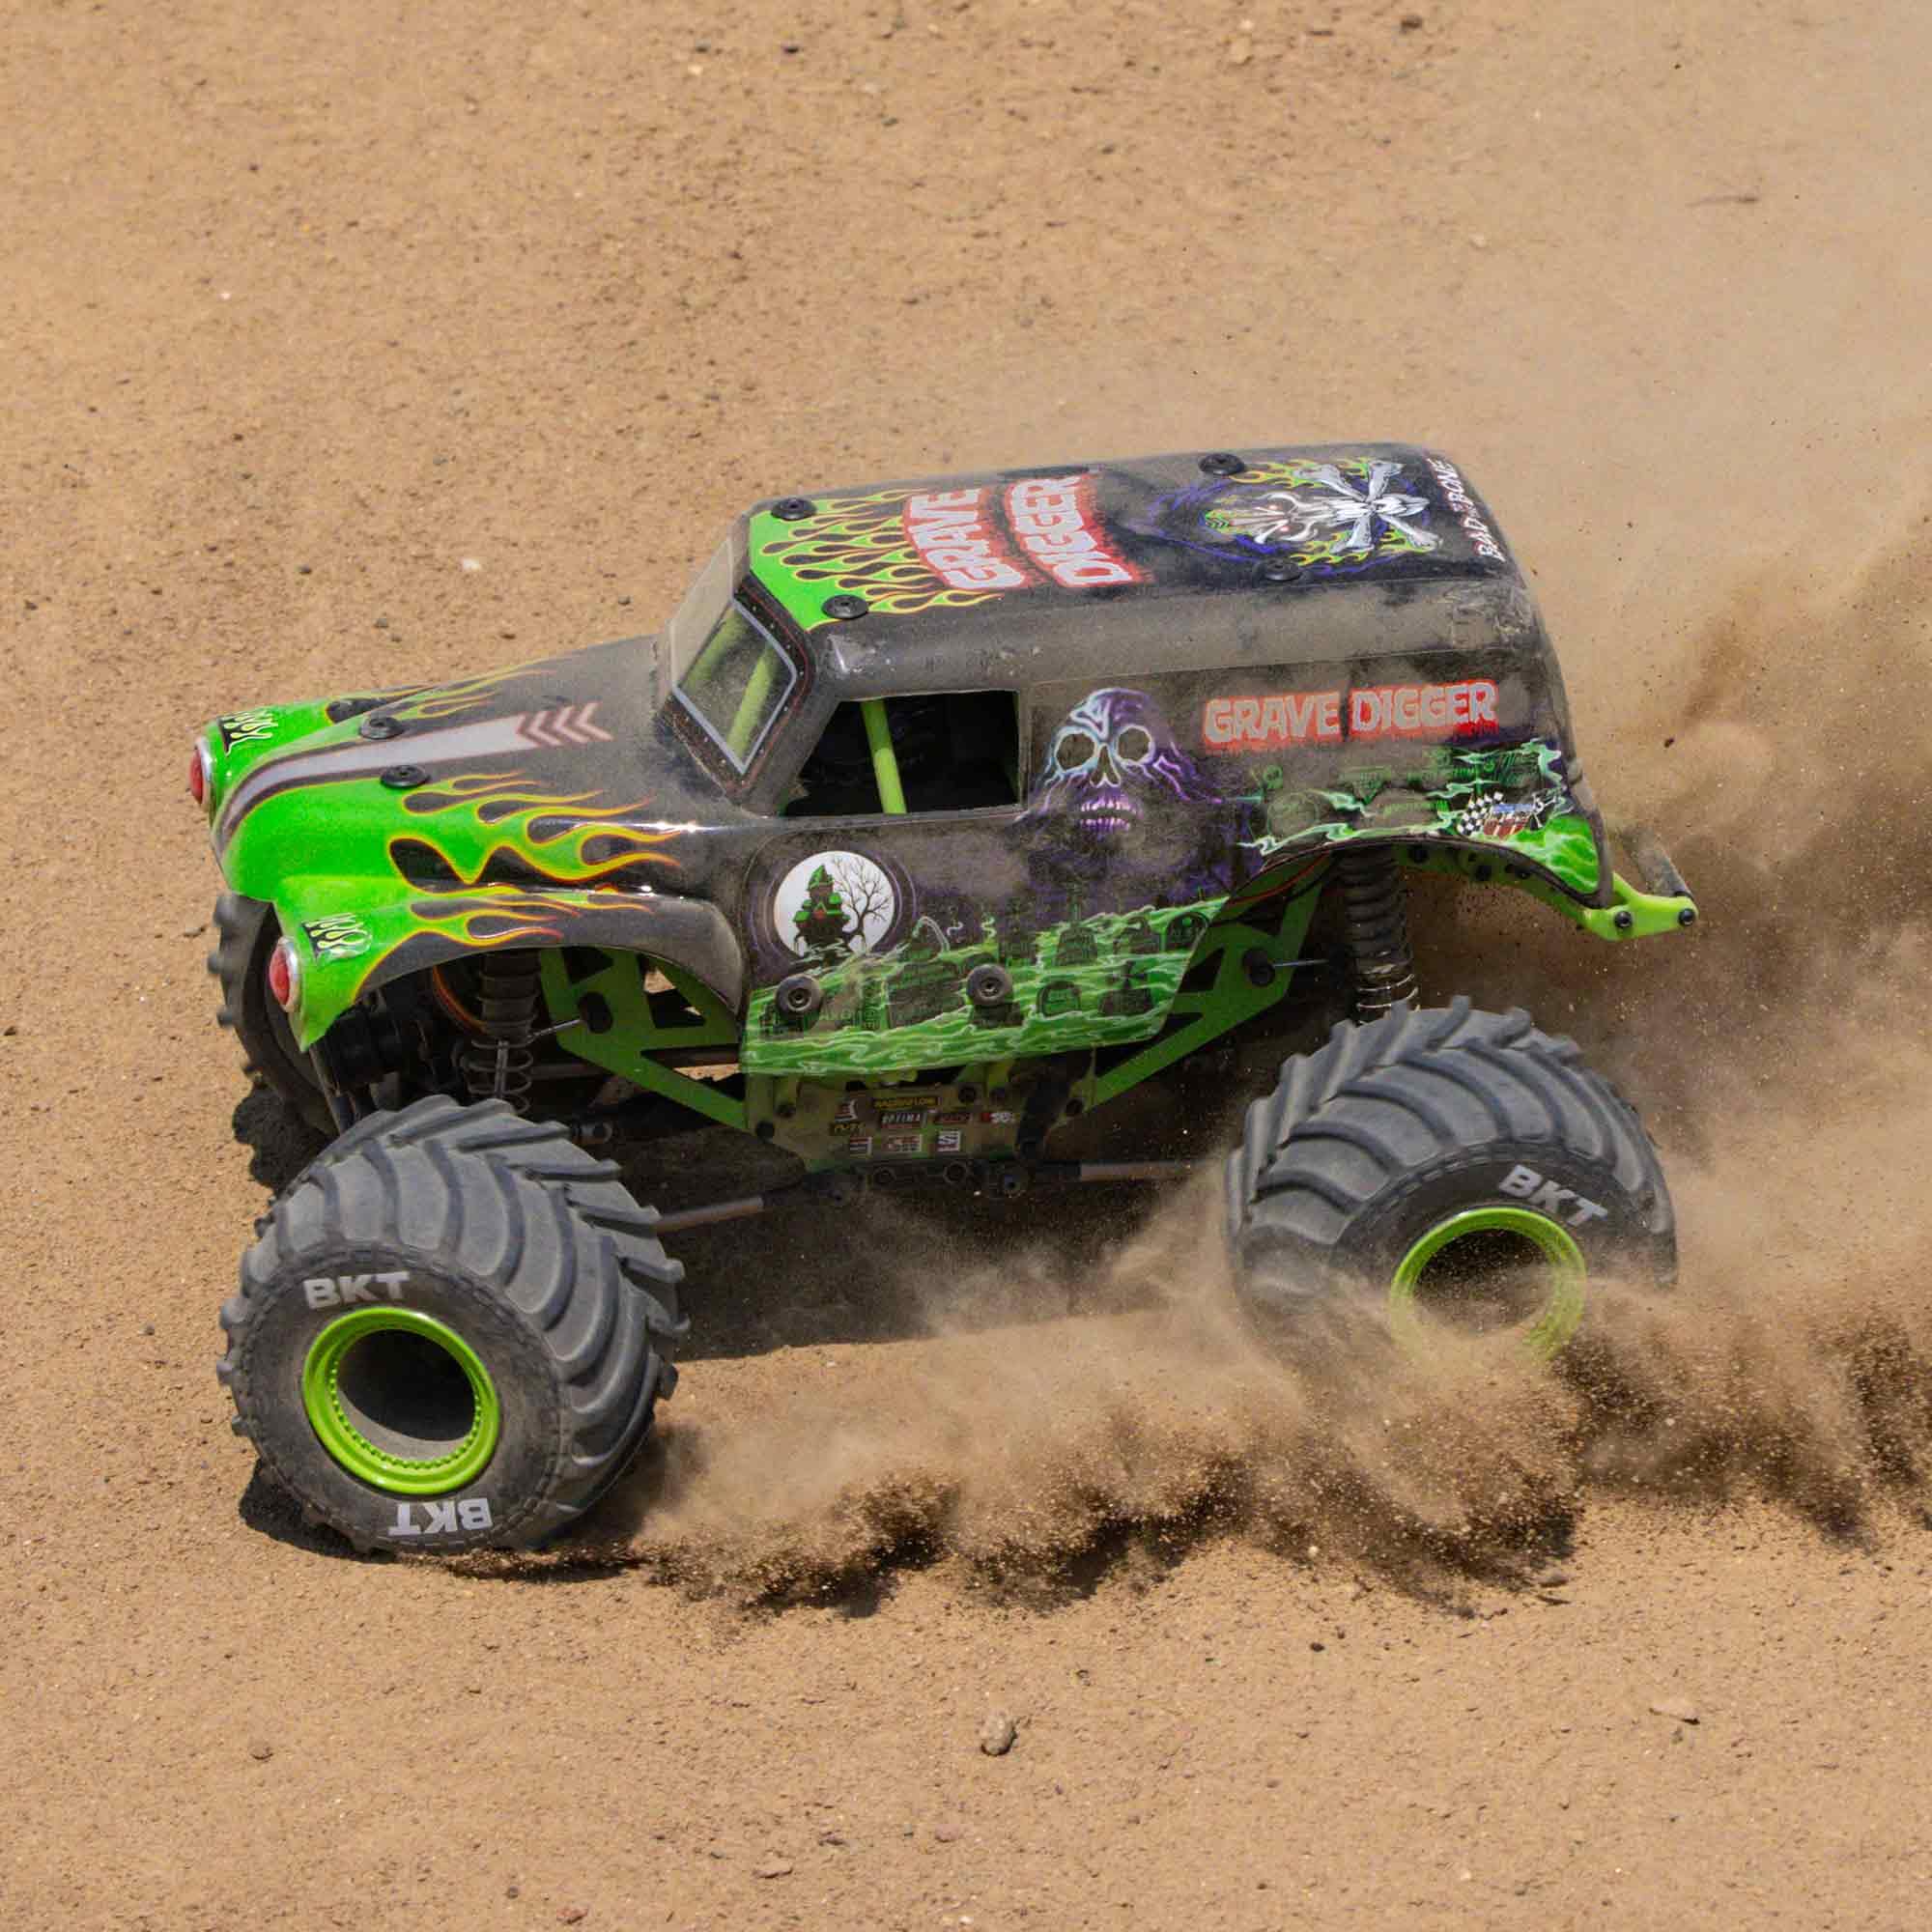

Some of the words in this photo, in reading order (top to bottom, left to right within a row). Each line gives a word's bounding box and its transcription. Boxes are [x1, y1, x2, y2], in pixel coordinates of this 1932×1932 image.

[1426, 458, 1474, 506] BONE
[905, 487, 1027, 589] GRAVE
[1007, 475, 1136, 590] DIGGER
[1463, 516, 1506, 562] BAD
[1205, 692, 1341, 744] GRAVE
[1349, 680, 1499, 733] DIGGER
[1498, 1163, 1608, 1227] BKT
[303, 1270, 411, 1310] BKT
[387, 1497, 493, 1537] BKT
